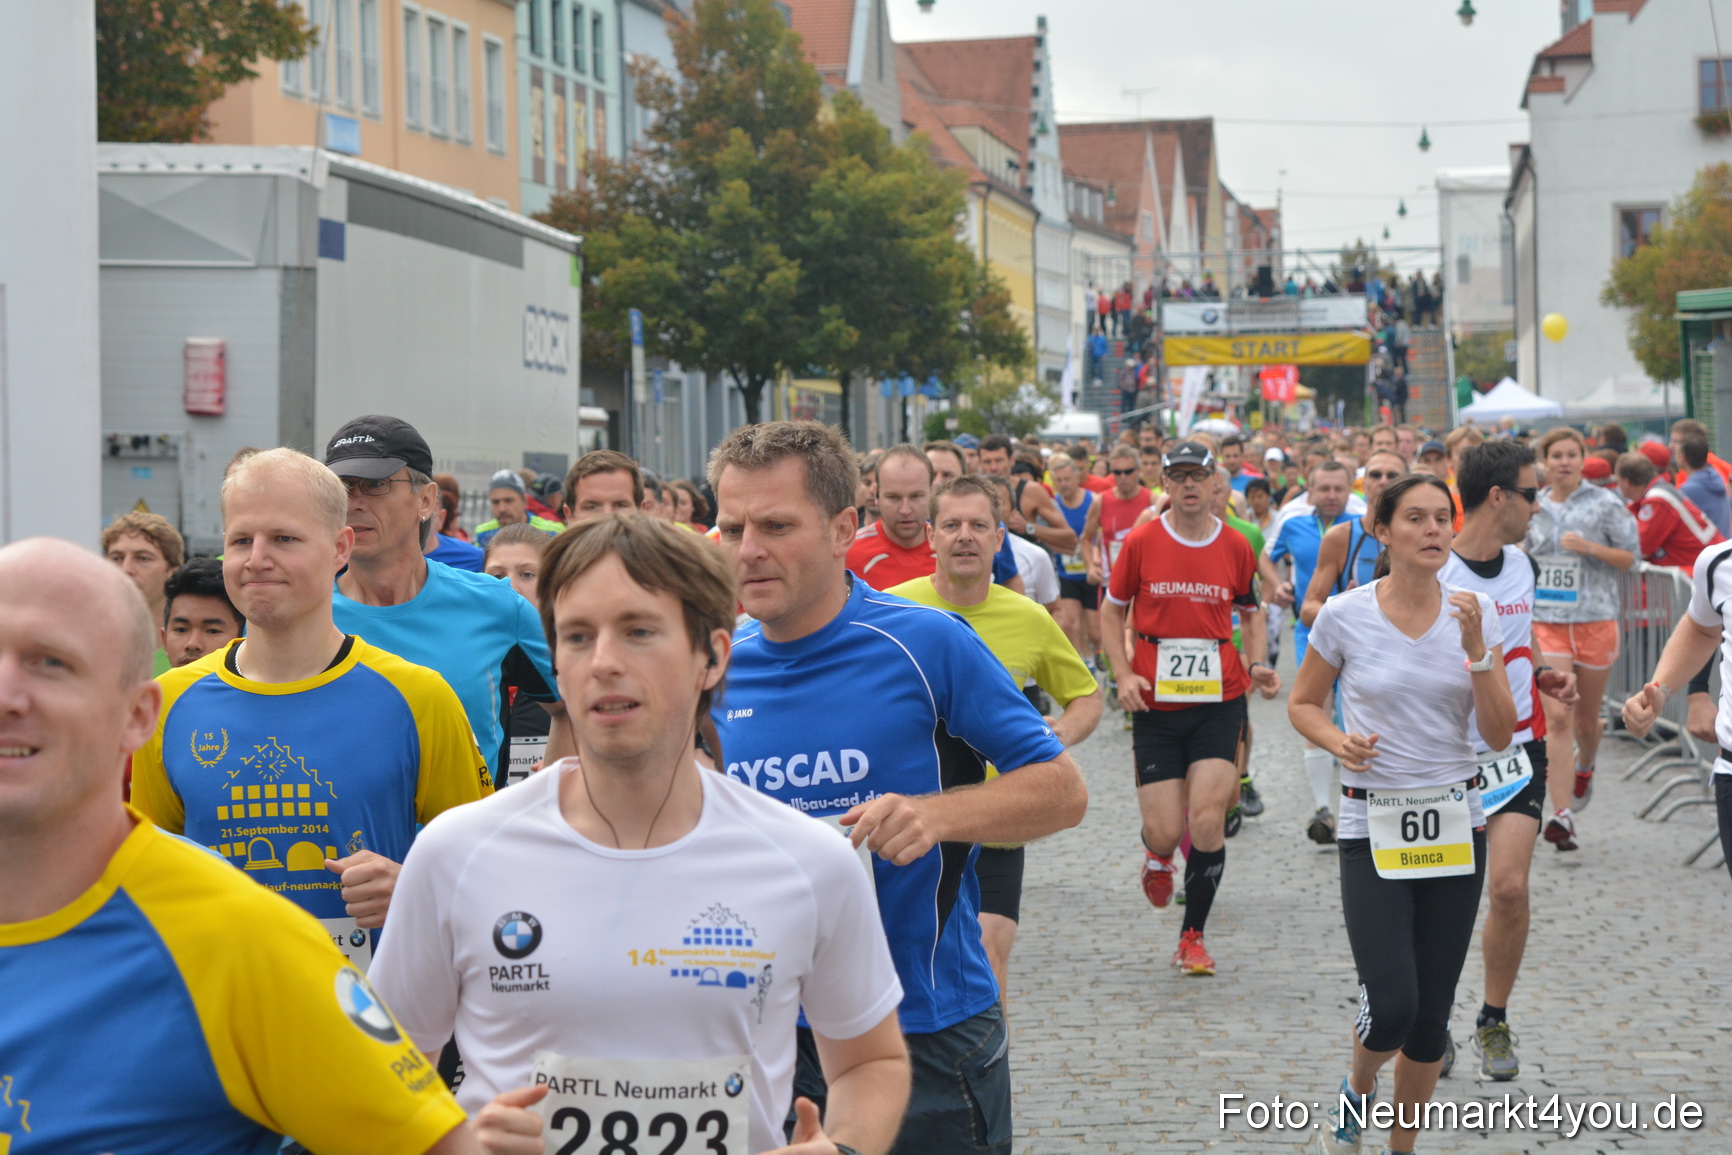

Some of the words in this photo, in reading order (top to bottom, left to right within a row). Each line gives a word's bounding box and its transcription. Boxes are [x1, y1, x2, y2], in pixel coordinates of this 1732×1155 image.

[1231, 340, 1302, 359] START
[1150, 581, 1221, 598] NEUMARKT
[1170, 654, 1210, 678] 274
[1175, 681, 1205, 693] Jürgen
[733, 708, 753, 719] JAKO
[204, 732, 214, 740] 15
[198, 743, 220, 752] Jahre
[1369, 799, 1403, 807] PARTL
[1405, 794, 1451, 806] Neumarkt
[220, 824, 299, 838] 21.September
[302, 824, 329, 834] 2014
[1401, 808, 1440, 843] 60
[1400, 852, 1444, 866] Bianca
[627, 949, 665, 966] 14.
[489, 962, 550, 981] PARTL
[491, 980, 550, 993] Neumarkt
[535, 1072, 607, 1097] PARTL
[614, 1080, 717, 1099] Neumarkt
[549, 1106, 730, 1155] 2823
